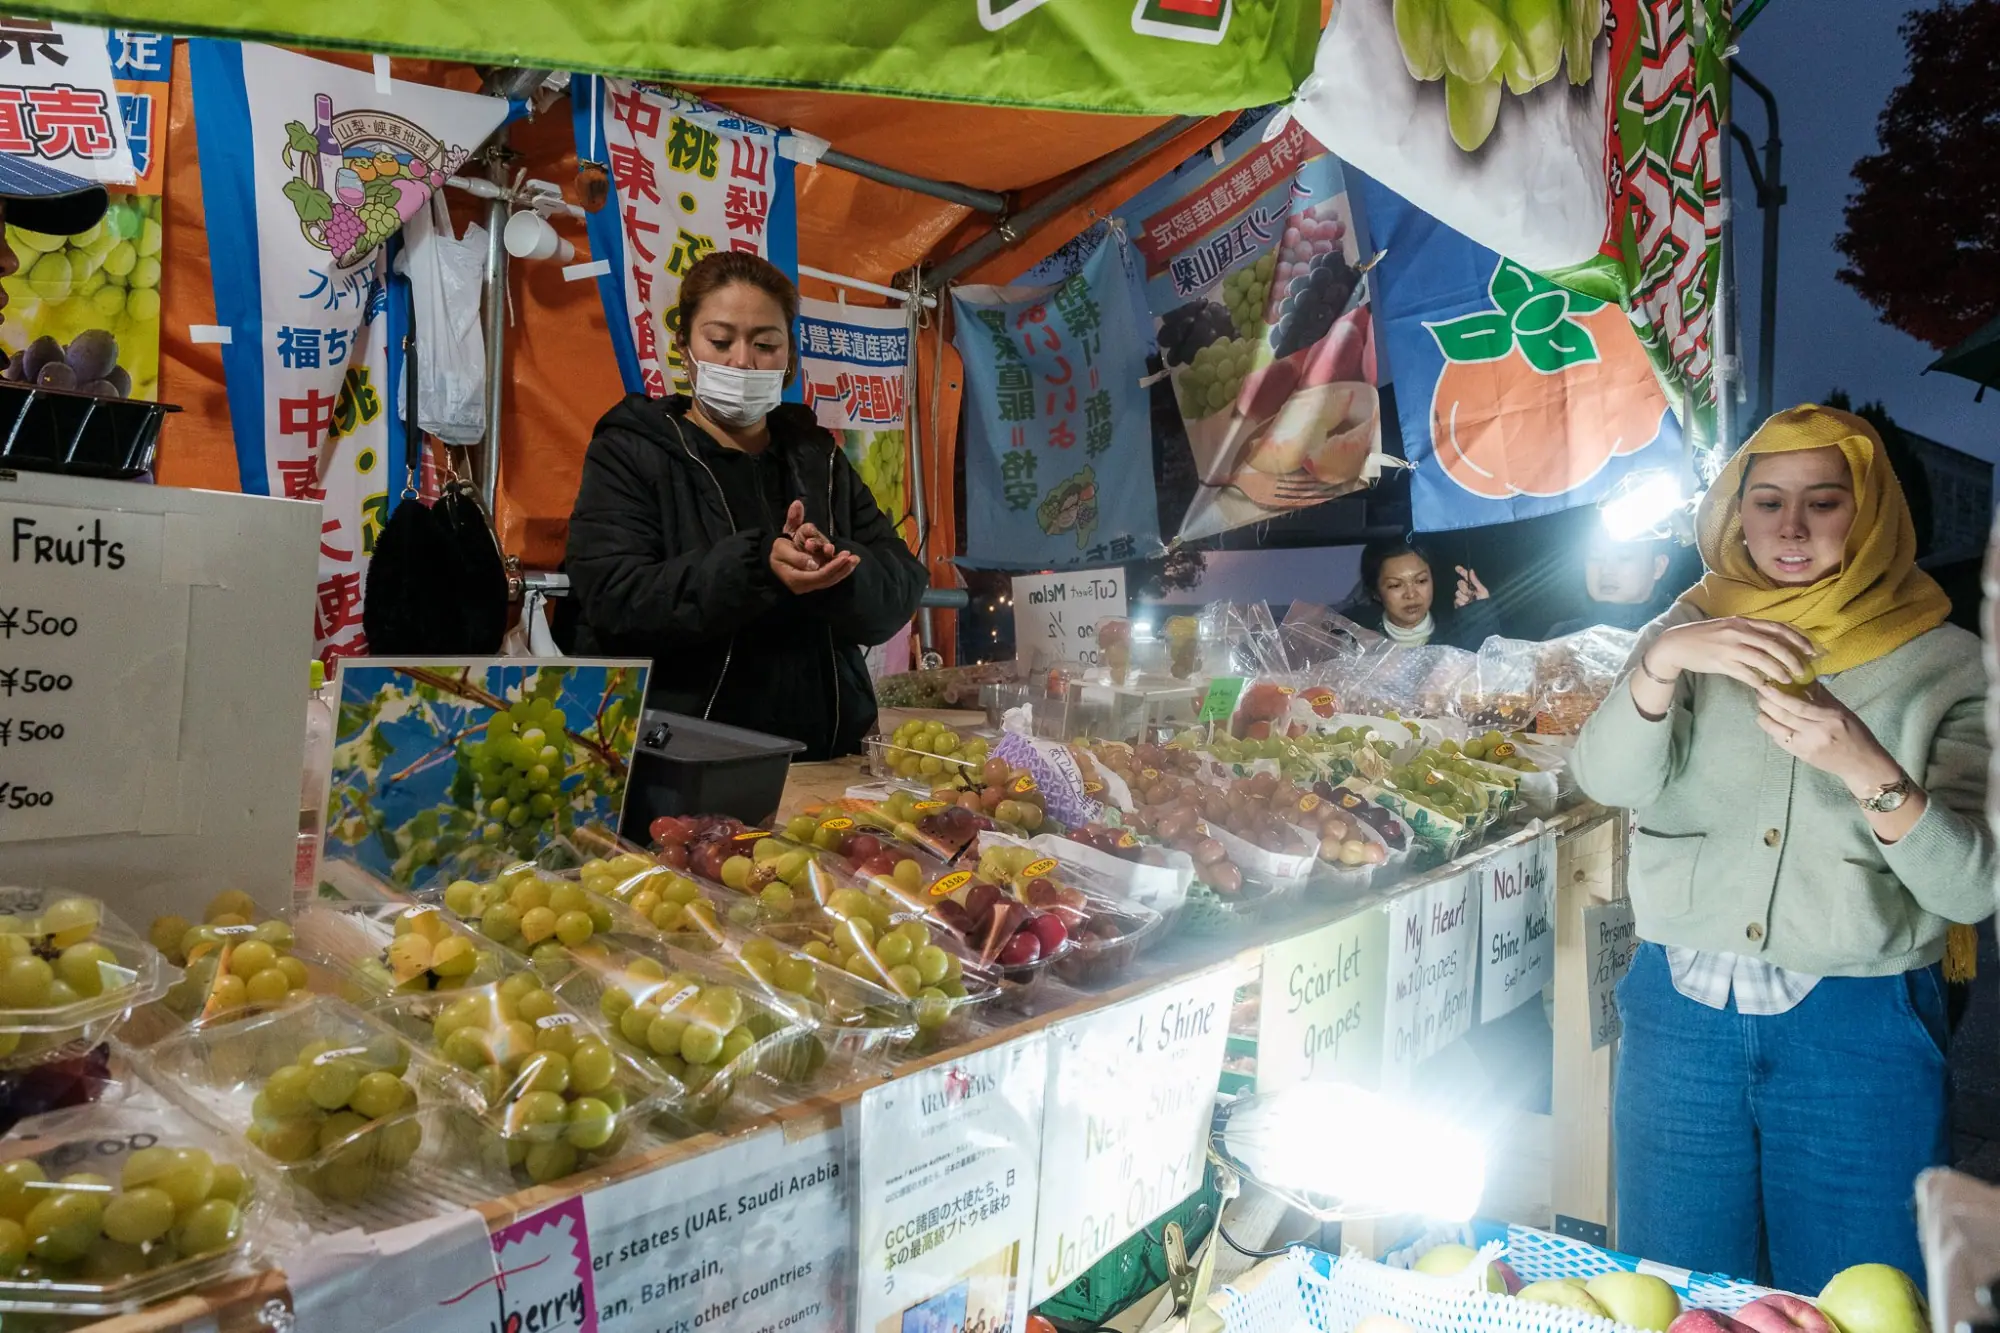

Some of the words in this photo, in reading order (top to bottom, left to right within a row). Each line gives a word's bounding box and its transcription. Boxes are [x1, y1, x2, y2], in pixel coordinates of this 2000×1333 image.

[0, 606, 78, 640] ¥500
[0, 667, 73, 697] ¥500
[1404, 913, 1424, 965] My
[1431, 885, 1468, 937] Heart
[1491, 930, 1520, 965] Shine
[1287, 935, 1362, 1014] Scarlet
[1157, 997, 1216, 1051] Shine
[619, 1226, 680, 1263] states
[685, 1205, 732, 1239] (UAE,
[738, 1180, 785, 1217] Saudi
[789, 1162, 841, 1195] Arabia
[641, 1259, 724, 1305] Bahrain,
[694, 1296, 739, 1328] other
[743, 1261, 813, 1305] countries
[884, 1274, 895, 1296] う
